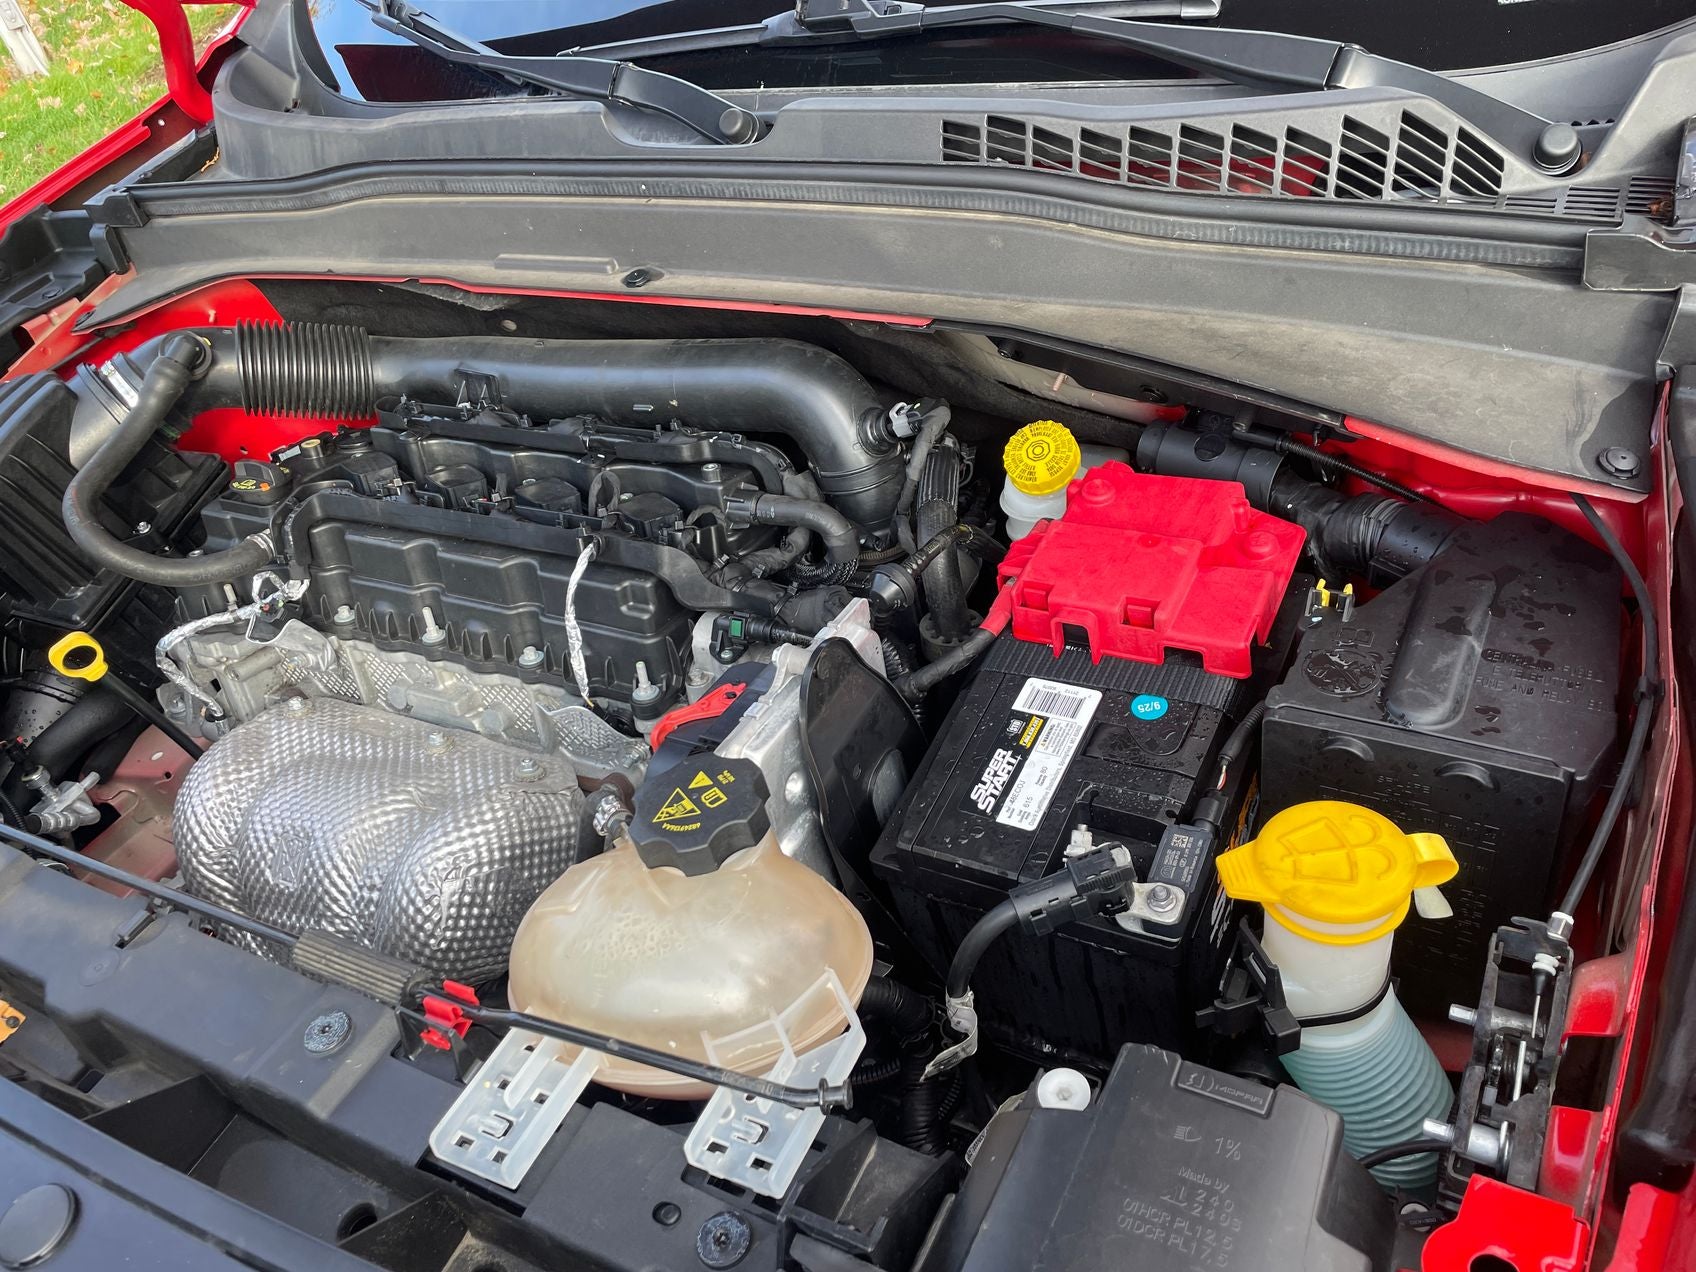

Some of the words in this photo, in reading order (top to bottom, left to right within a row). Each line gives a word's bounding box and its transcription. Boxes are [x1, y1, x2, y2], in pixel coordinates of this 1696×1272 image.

[1137, 700, 1161, 714] 9/25
[970, 748, 1008, 800] SUPER
[977, 750, 1018, 814] START
[1215, 1137, 1241, 1160] 1%
[1178, 1166, 1211, 1186] Made
[1213, 1177, 1230, 1193] by
